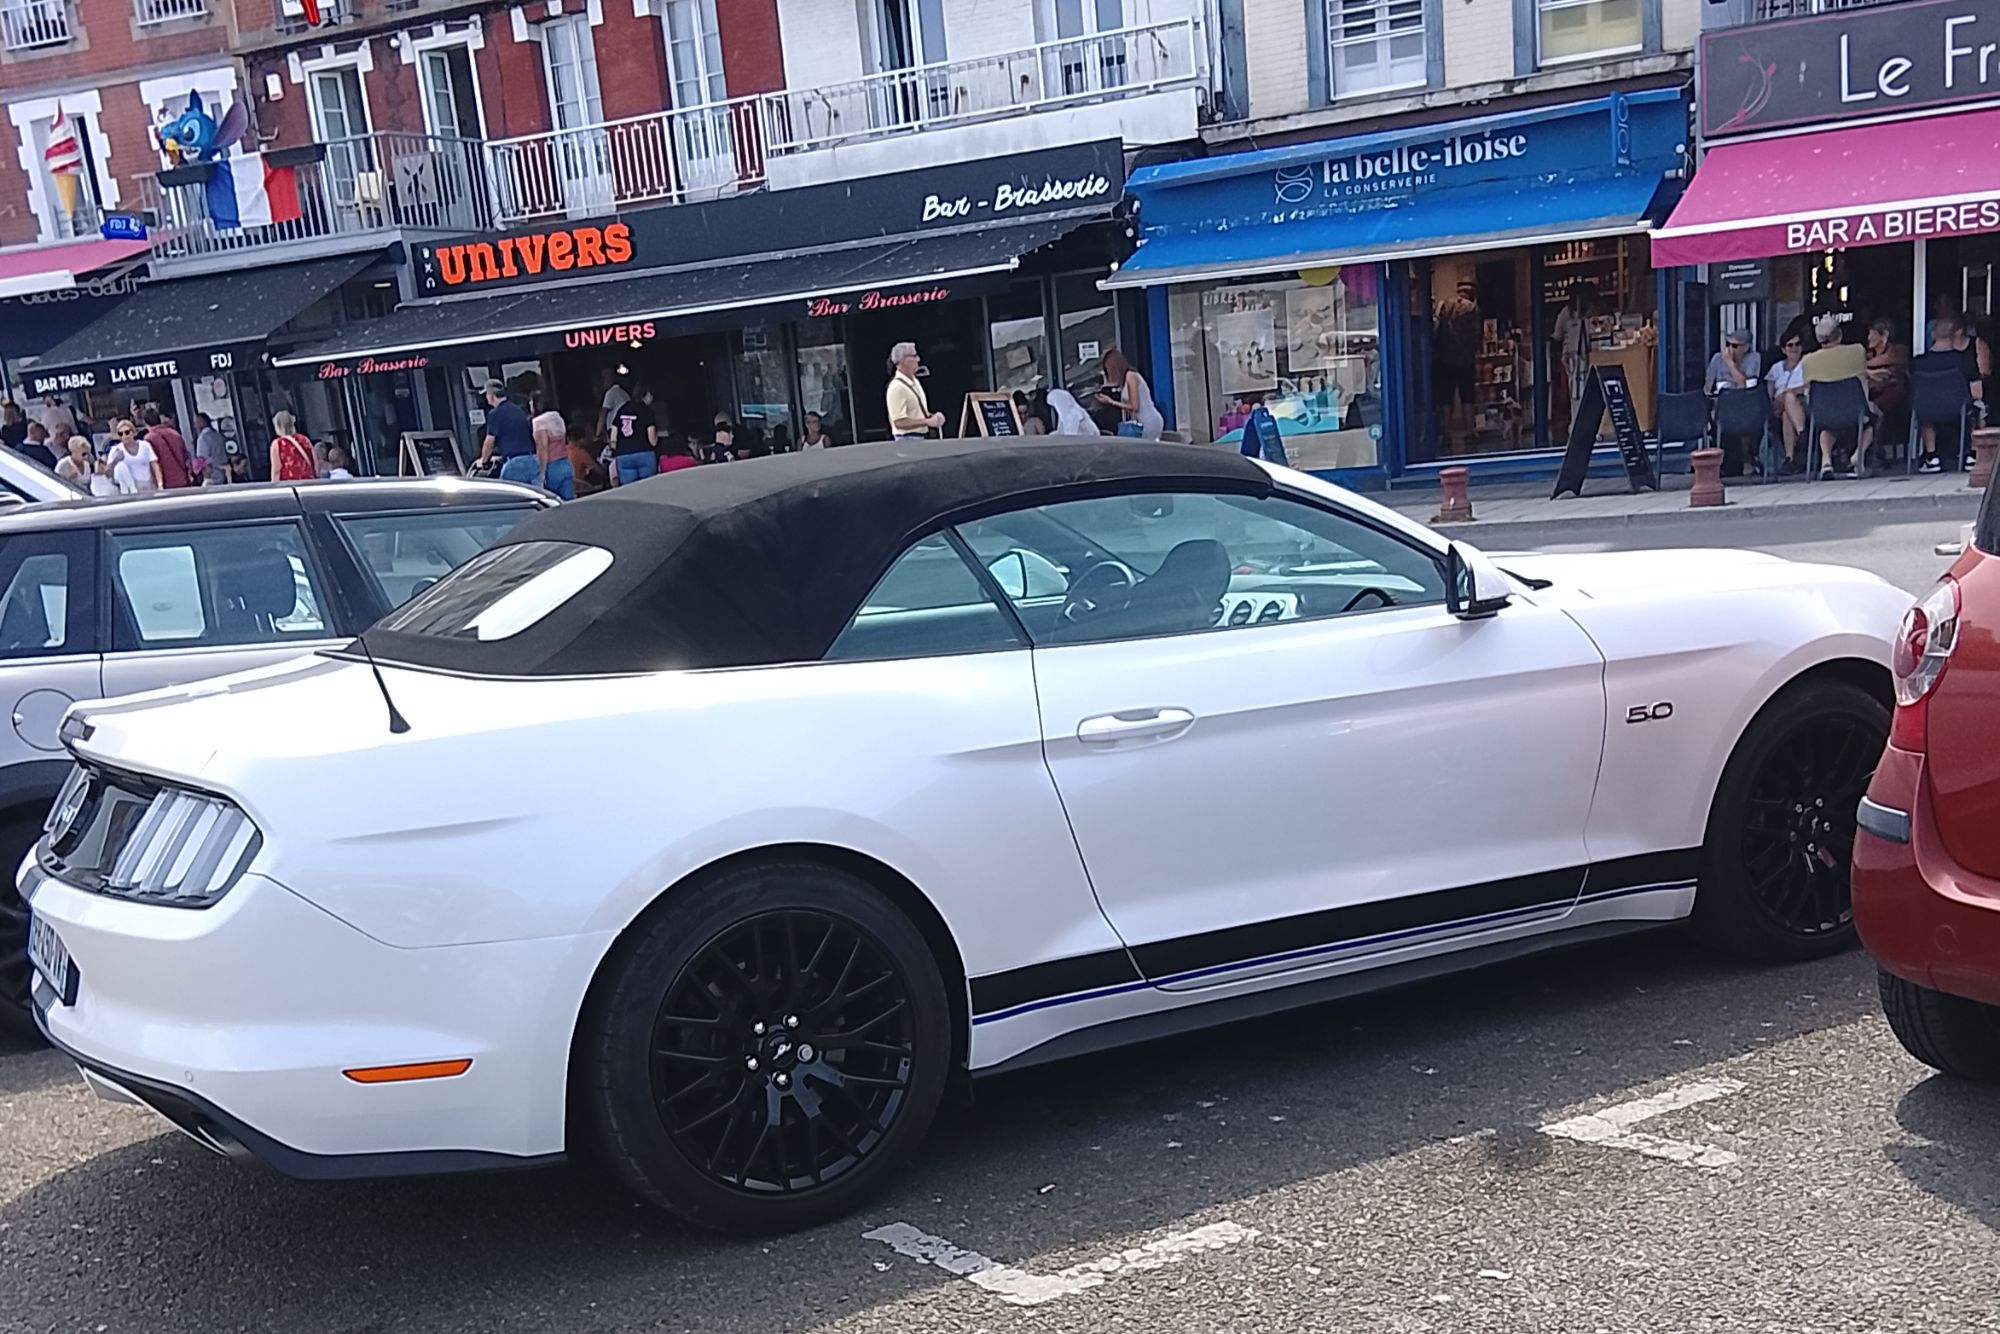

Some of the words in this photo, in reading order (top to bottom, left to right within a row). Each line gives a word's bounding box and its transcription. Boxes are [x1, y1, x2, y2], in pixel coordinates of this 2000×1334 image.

[1840, 33, 1912, 103] Le
[1945, 15, 2000, 88] Fr
[1322, 159, 1350, 184] la
[1355, 131, 1527, 180] belle-iloise
[921, 195, 970, 222] Bar
[994, 173, 1110, 211] Brasserie
[1323, 187, 1339, 198] LA
[1345, 174, 1436, 195] CONSERVERIE
[1787, 217, 1849, 249] BAR
[1855, 216, 1877, 241] A
[1884, 201, 1999, 237] BIERES
[810, 298, 851, 317] Bar
[859, 286, 950, 310] Brasserie
[565, 322, 655, 348] UNIVERS
[110, 366, 125, 383] LA
[126, 361, 178, 380] CIVETTE
[210, 353, 233, 369] FDJ
[318, 362, 350, 379] Bar
[357, 355, 428, 375] Brasserie
[35, 377, 58, 393] BAR
[58, 372, 95, 390] TABAC
[1626, 702, 1673, 724] 5.0
